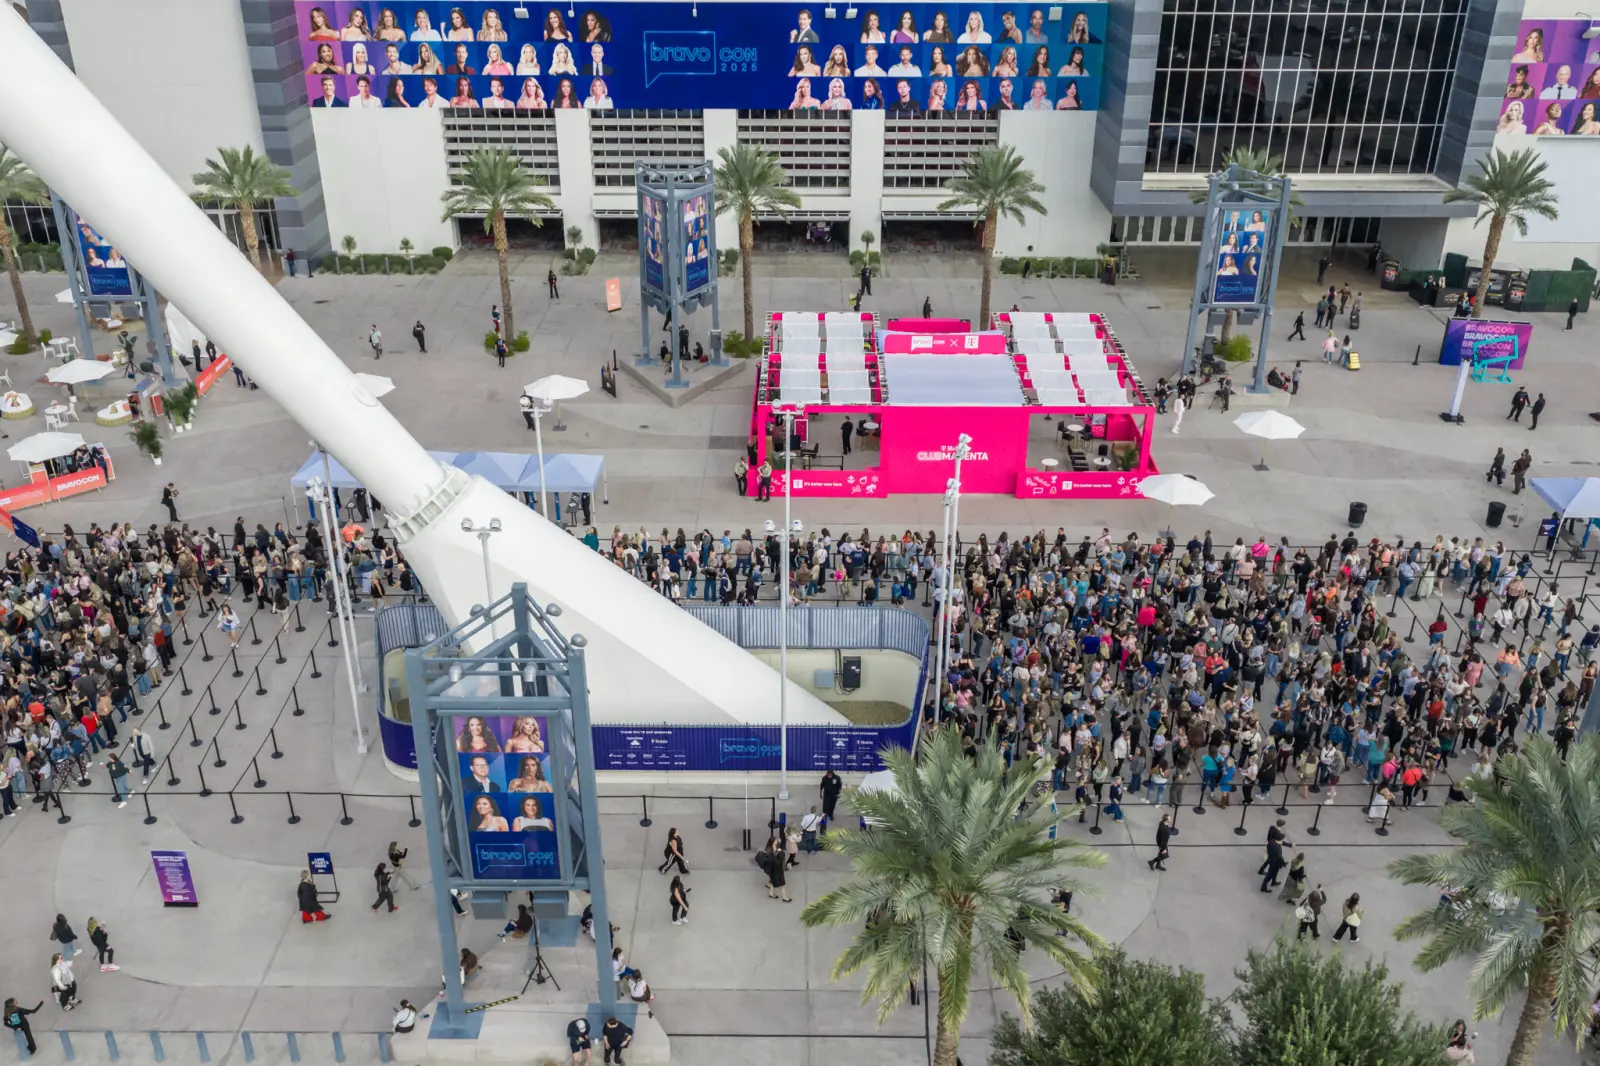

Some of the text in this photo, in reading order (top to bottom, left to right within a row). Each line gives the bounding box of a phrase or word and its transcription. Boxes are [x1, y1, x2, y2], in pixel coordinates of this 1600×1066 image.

[650, 41, 757, 62] bravo CON
[721, 63, 757, 72] 2025
[1465, 324, 1515, 334] BRAVOCON
[1463, 332, 1513, 342] BRAVOC
[56, 474, 100, 492] BRAVOCON
[723, 742, 757, 752] bravo
[480, 848, 554, 860] bravo CON
